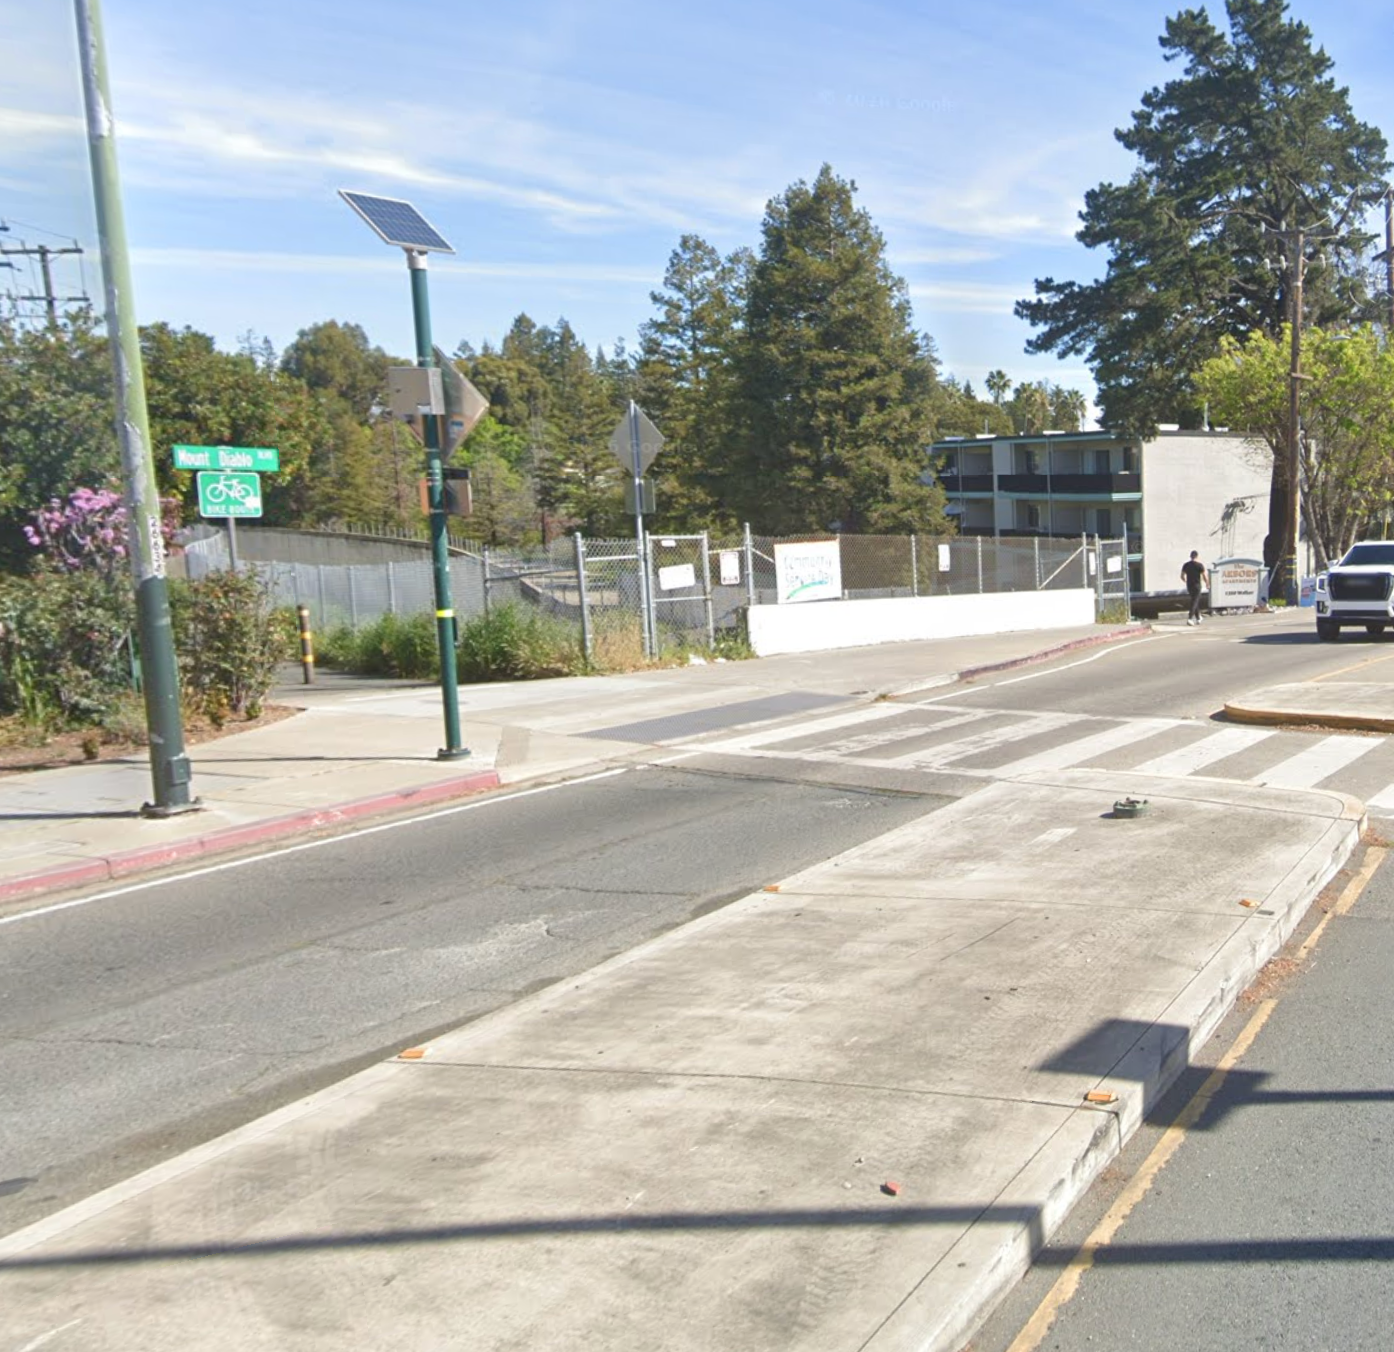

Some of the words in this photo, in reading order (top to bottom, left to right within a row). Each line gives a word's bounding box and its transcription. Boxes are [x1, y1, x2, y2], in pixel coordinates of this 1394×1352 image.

[177, 449, 210, 466] Mount
[218, 450, 253, 467] Diablo
[207, 504, 227, 514] BIKE
